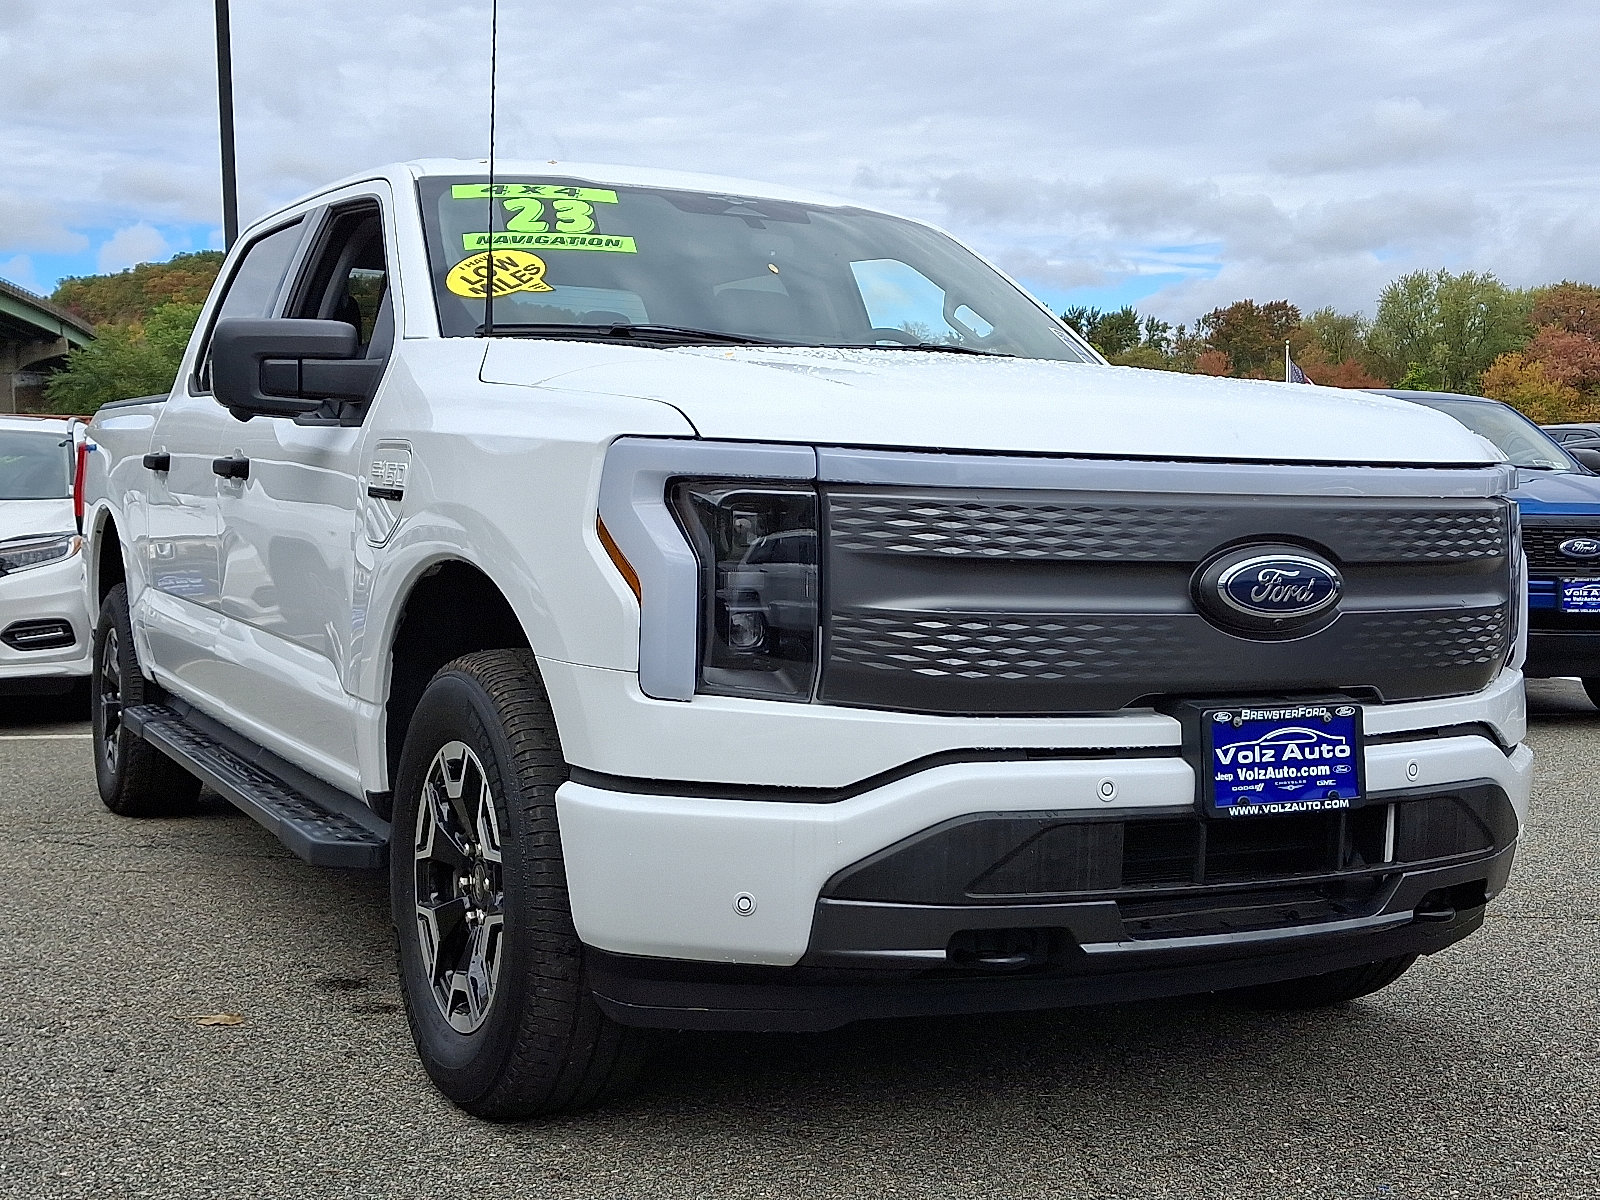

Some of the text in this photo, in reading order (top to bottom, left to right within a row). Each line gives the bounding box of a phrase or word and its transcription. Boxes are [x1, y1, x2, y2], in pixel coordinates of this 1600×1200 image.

[502, 197, 595, 234] 23
[476, 235, 622, 248] NAVIGATION
[460, 256, 519, 285] LOW
[465, 254, 496, 268] HAV
[469, 264, 541, 295] MILES
[1572, 541, 1597, 553] Ford
[1250, 568, 1316, 602] Ford
[1215, 743, 1351, 764] Volz Auto
[1215, 772, 1234, 782] Jeep
[1237, 765, 1330, 781] VolzAuto.com
[1229, 799, 1349, 816] WWW.VOLZAUTO.COM
